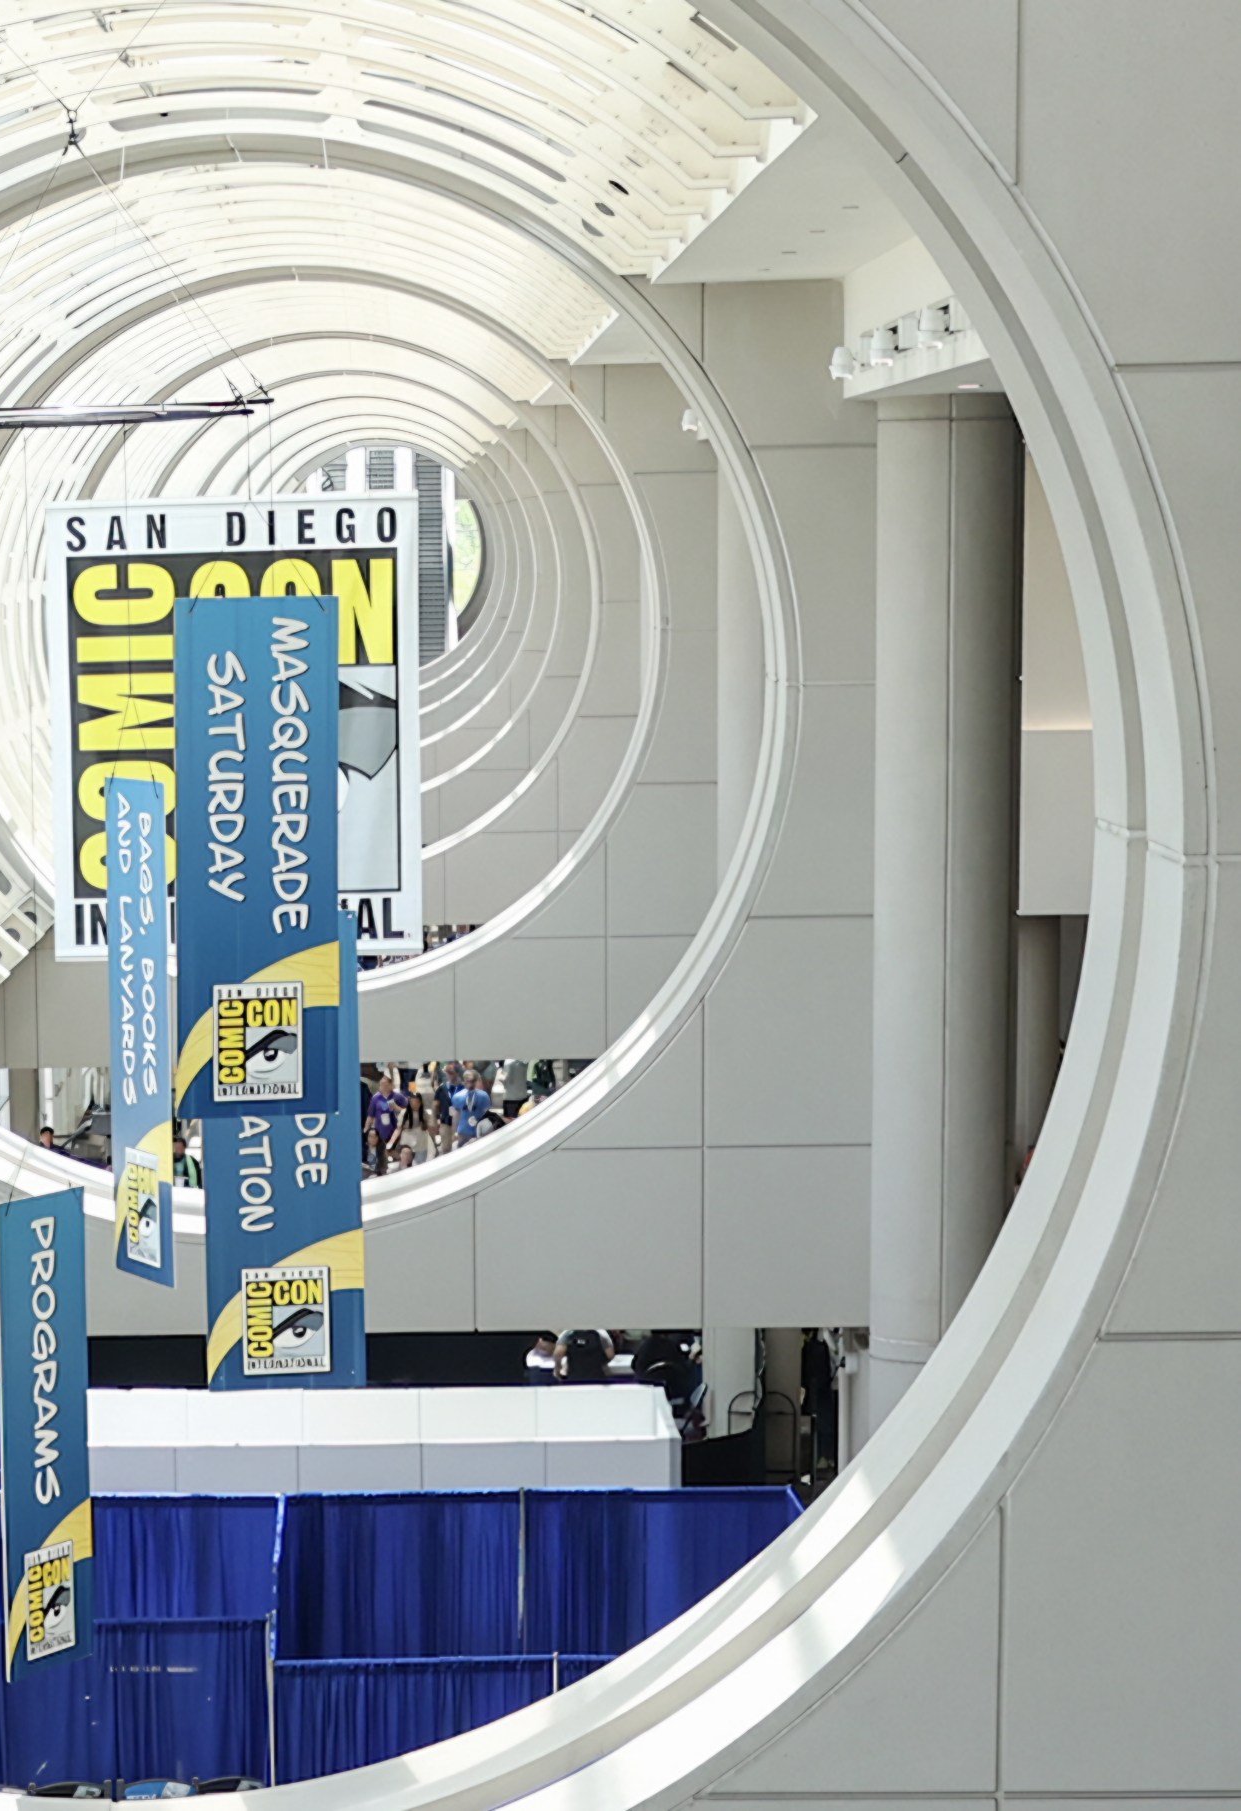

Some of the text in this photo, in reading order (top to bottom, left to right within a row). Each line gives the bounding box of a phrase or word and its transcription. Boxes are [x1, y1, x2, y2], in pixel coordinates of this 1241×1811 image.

[66, 506, 398, 552] SAN DIEGO
[207, 651, 247, 902] SATURDAY
[269, 617, 310, 934] MASQUERADE
[117, 792, 138, 1106] AND LANYARDS
[141, 958, 158, 1096] BOOKS
[219, 1000, 246, 1084] COMIC
[246, 998, 297, 1028] CON
[246, 1281, 274, 1358] COMIC
[273, 1279, 324, 1306] CON
[30, 1215, 61, 1505] PROGRAMS
